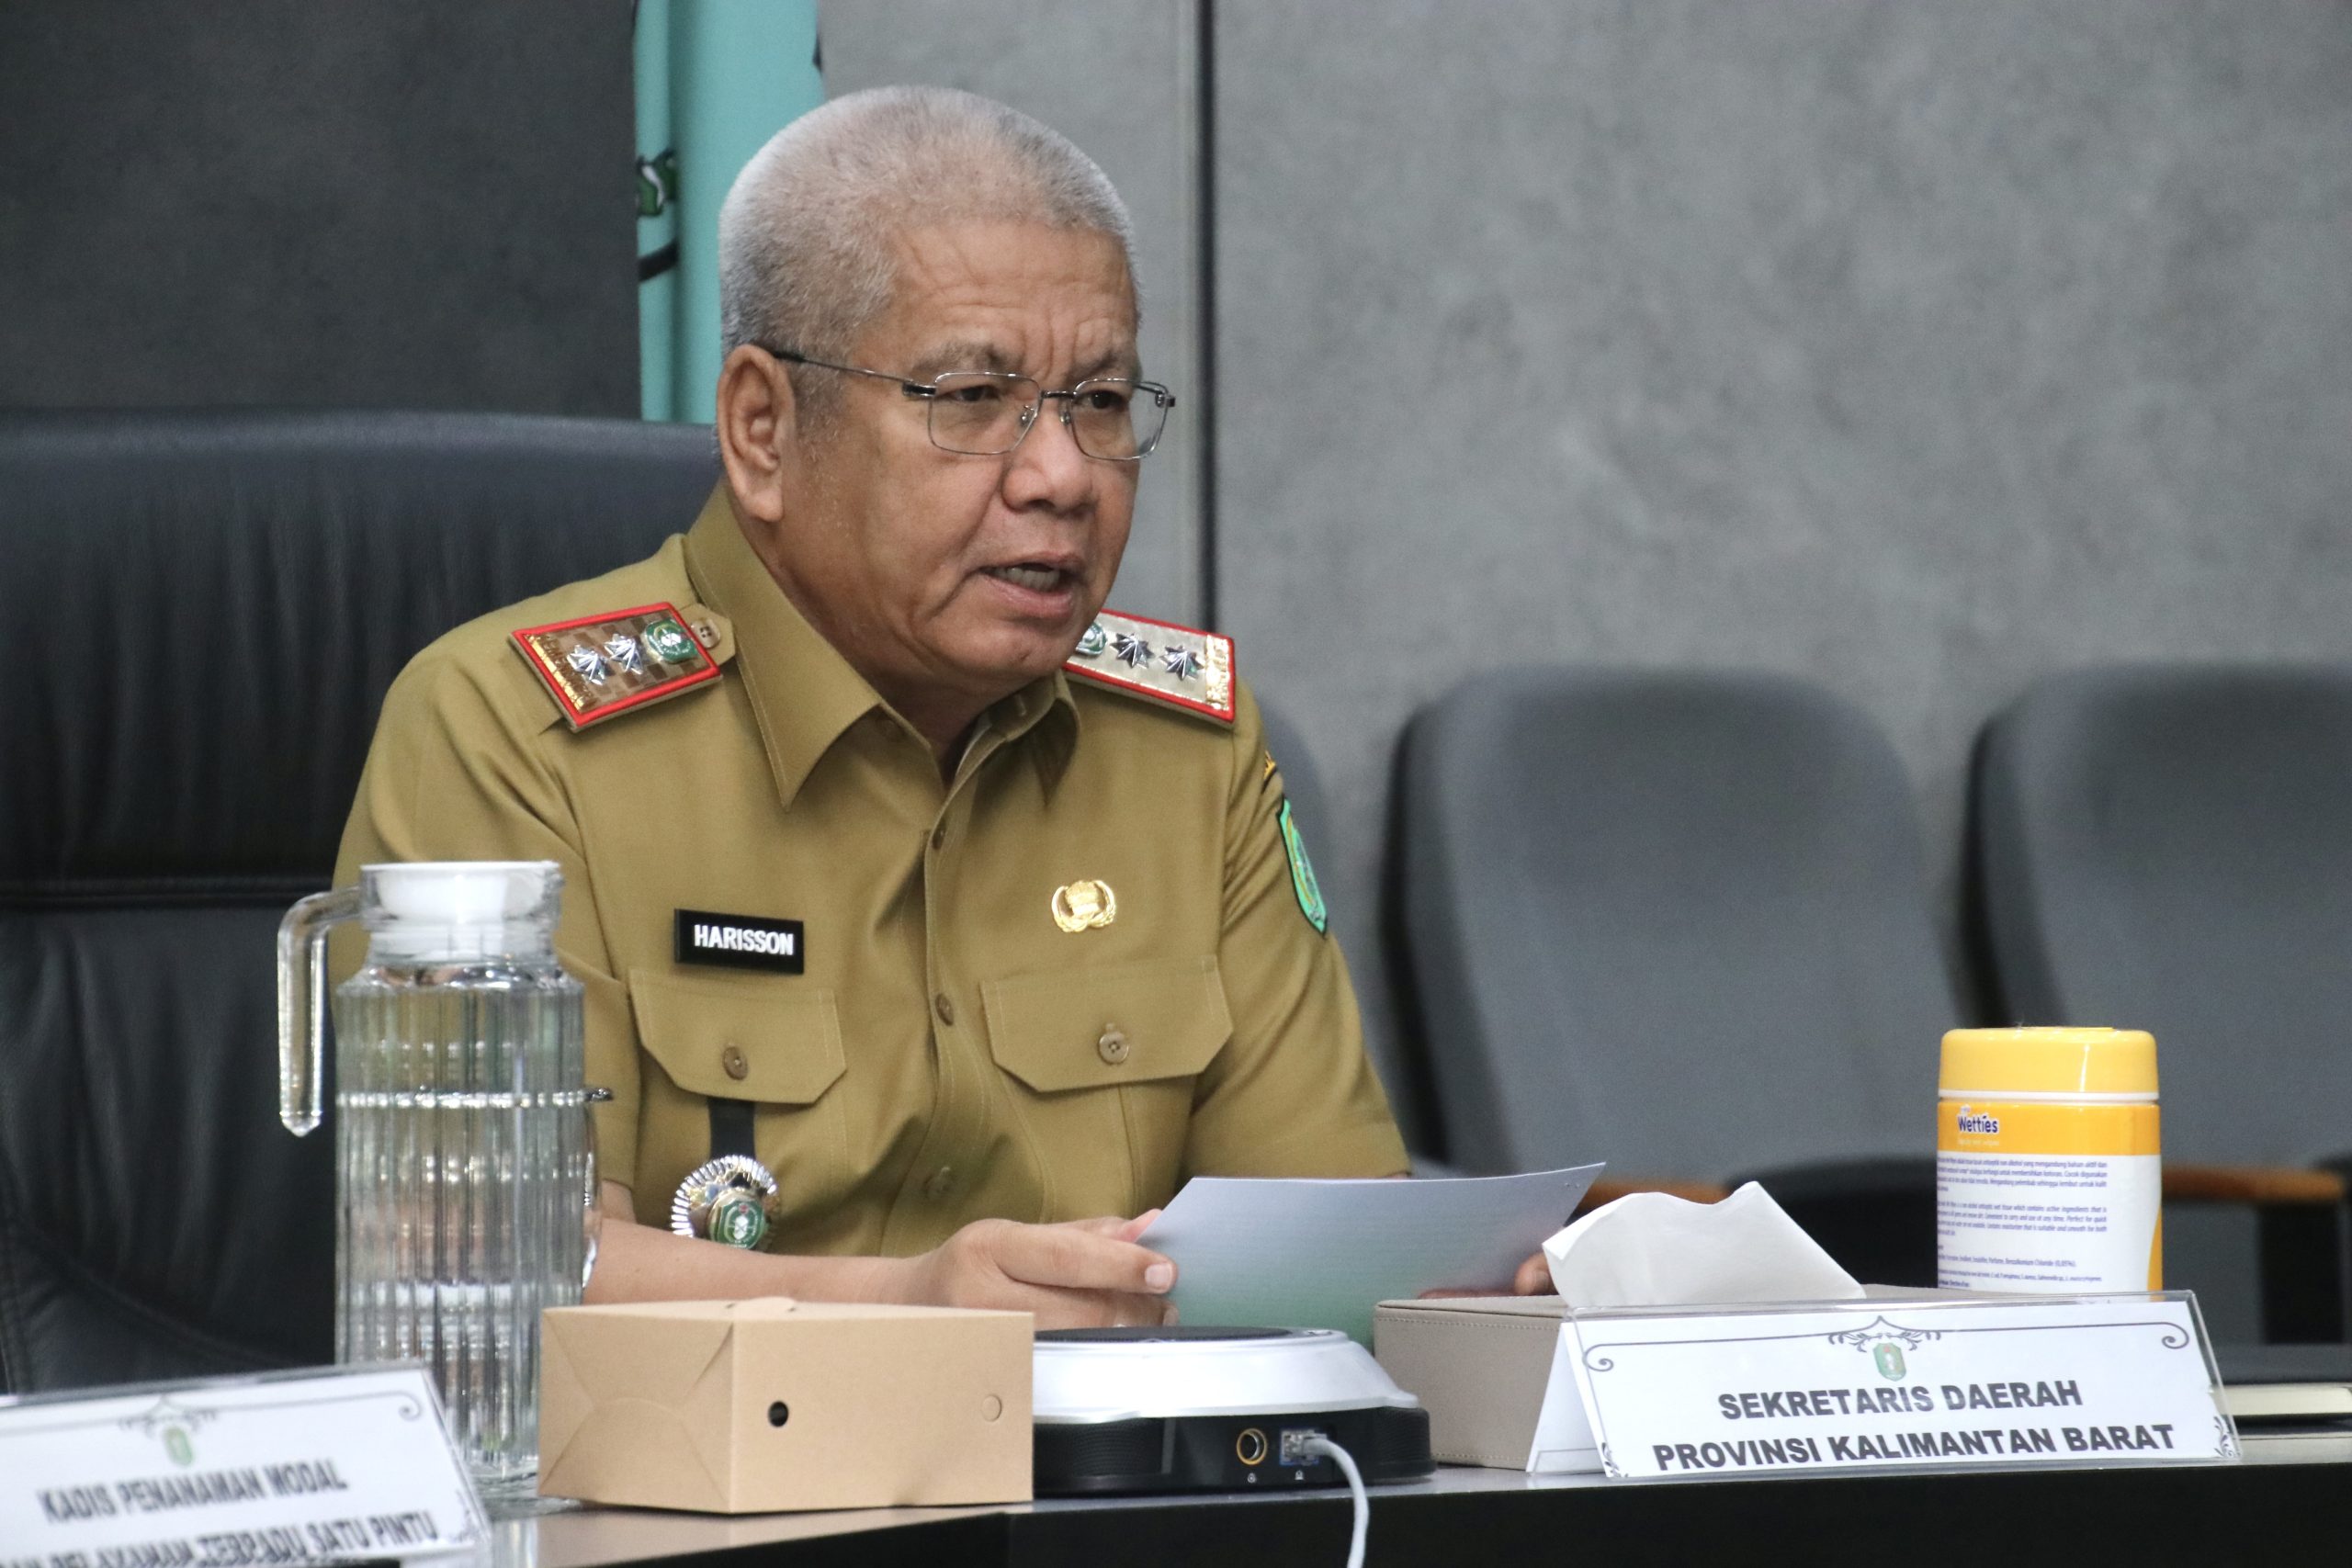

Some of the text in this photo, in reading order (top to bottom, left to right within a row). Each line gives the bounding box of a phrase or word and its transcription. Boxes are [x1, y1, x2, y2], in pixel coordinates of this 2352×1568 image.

[694, 924, 795, 955] HARISSON
[1957, 1114, 1998, 1134] Wetties
[1718, 1380, 2083, 1420] SEKRETARIS DAERAH
[1651, 1423, 2175, 1472] PROVINSI KALIMANTAN BARAT
[37, 1460, 348, 1523] KADIS PENANAMAN MODAL
[306, 1519, 369, 1554] SATU
[368, 1510, 438, 1548] PINTU
